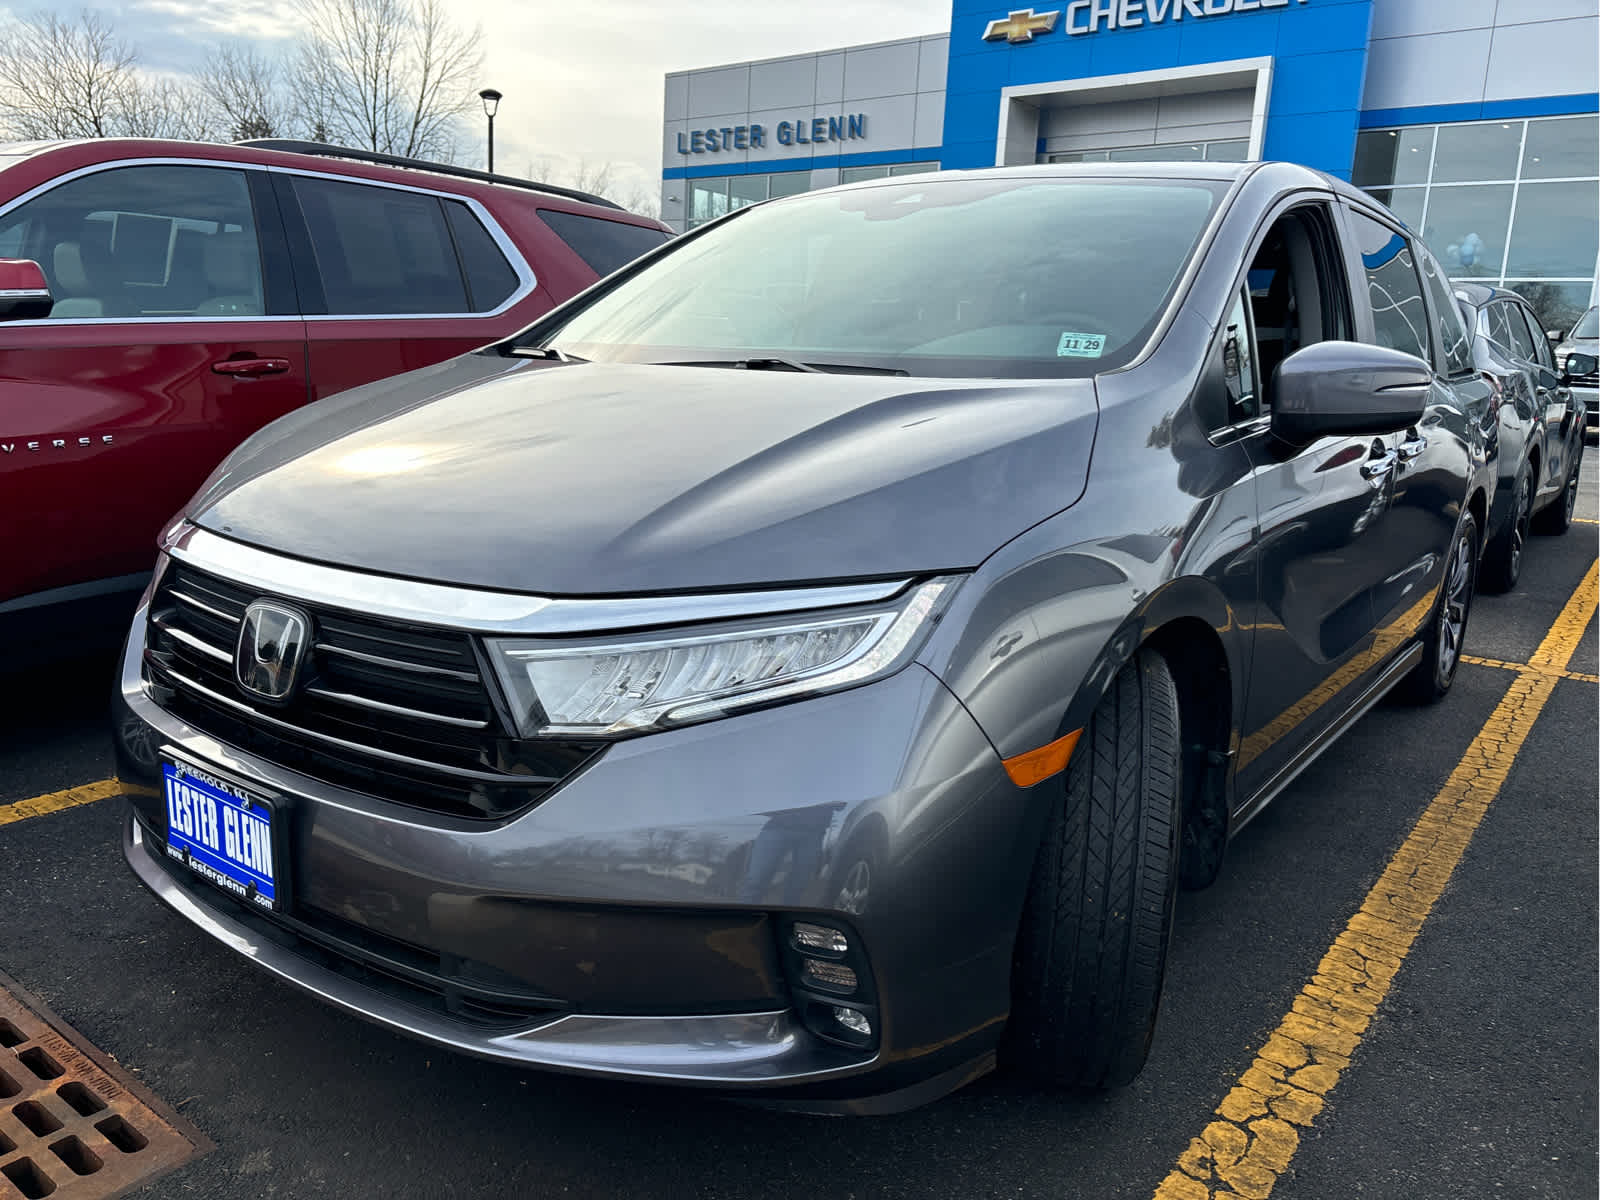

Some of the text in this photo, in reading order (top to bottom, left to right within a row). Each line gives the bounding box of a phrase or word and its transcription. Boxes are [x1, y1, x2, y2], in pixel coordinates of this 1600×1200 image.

[1065, 0, 1306, 35] CHEVR
[677, 113, 864, 154] LESTER GLENN
[1063, 339, 1100, 350] 11 29
[1, 435, 113, 453] VERSE
[167, 778, 273, 879] LESTER GLENN
[188, 855, 247, 897] lesterglenn
